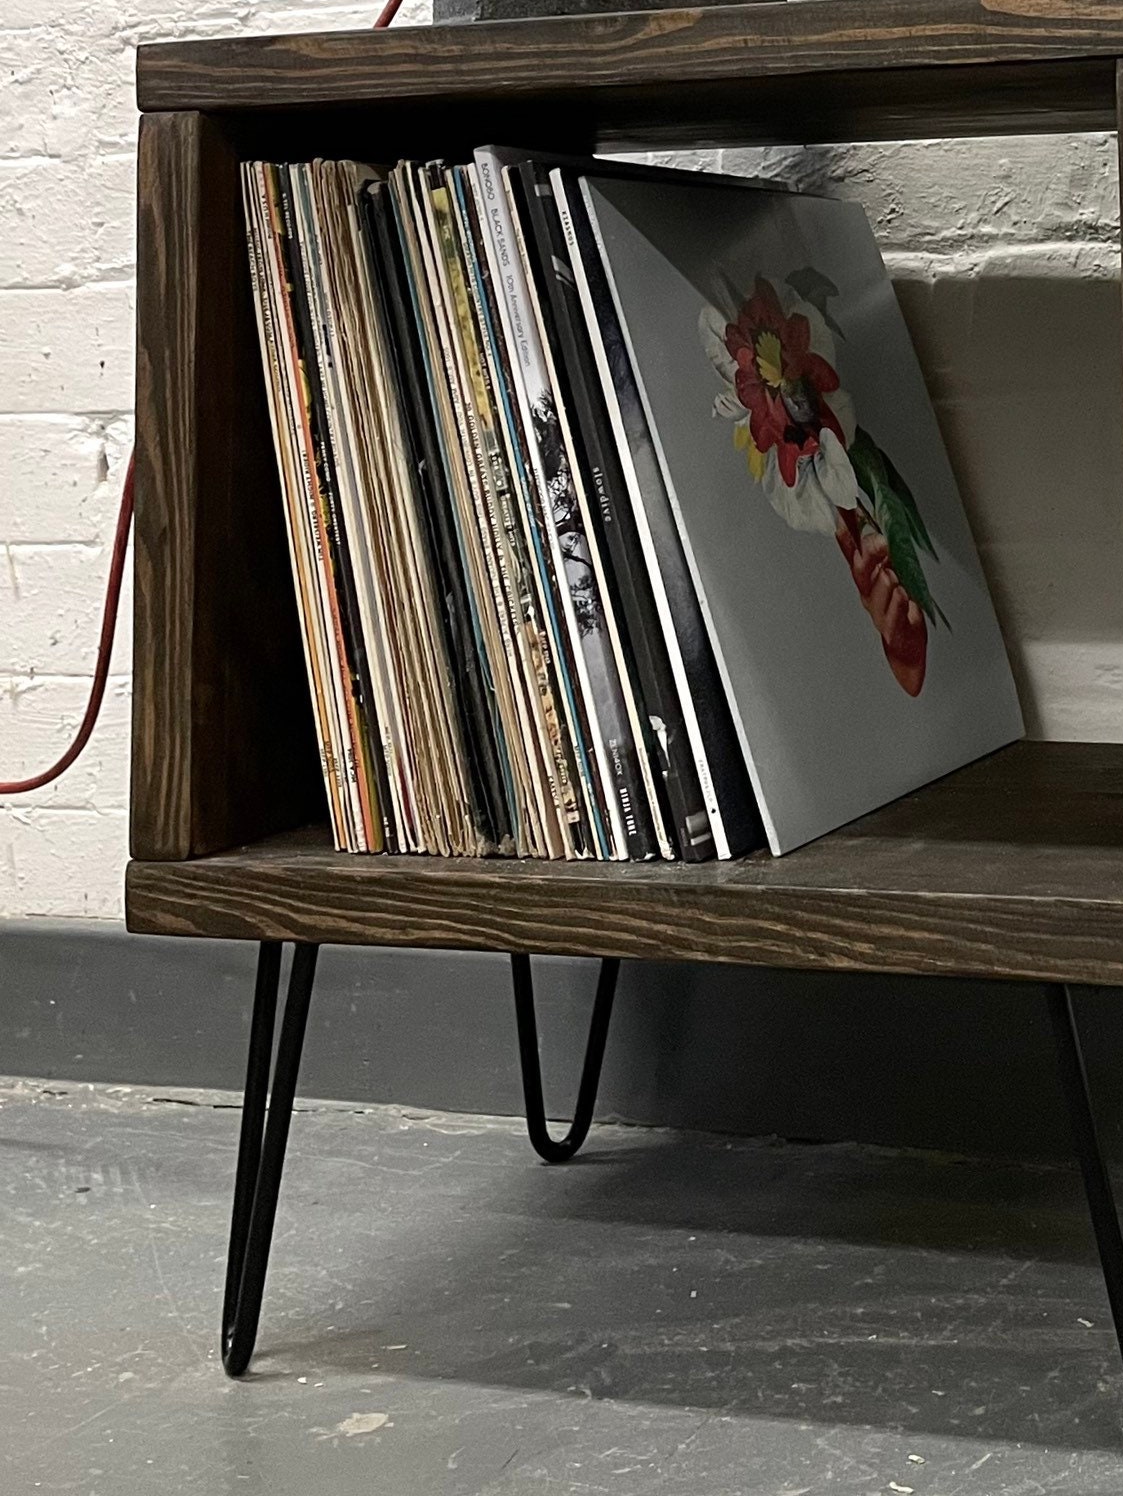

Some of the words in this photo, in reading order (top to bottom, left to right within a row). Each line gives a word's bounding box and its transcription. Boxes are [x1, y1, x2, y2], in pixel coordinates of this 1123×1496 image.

[479, 162, 496, 201] BONOBO
[489, 207, 504, 237] BLACK
[560, 210, 575, 246] KIASMOS
[497, 237, 511, 266] SANDS
[504, 274, 516, 292] 10th
[508, 293, 526, 338] Anniversary
[519, 339, 533, 367] Edition
[319, 441, 327, 461] PERRY
[322, 462, 330, 482] COMO
[467, 414, 480, 448] GOLDEN
[475, 452, 489, 485] GREATS
[483, 489, 496, 520] BUDDY
[491, 523, 503, 550] HOLLY
[592, 465, 613, 522] slowdive
[499, 495, 512, 529] GREATEST
[330, 513, 340, 545] GREATEST
[607, 737, 624, 776] ZEN140X
[618, 786, 631, 812] NINJA
[624, 814, 637, 836] TUNE
